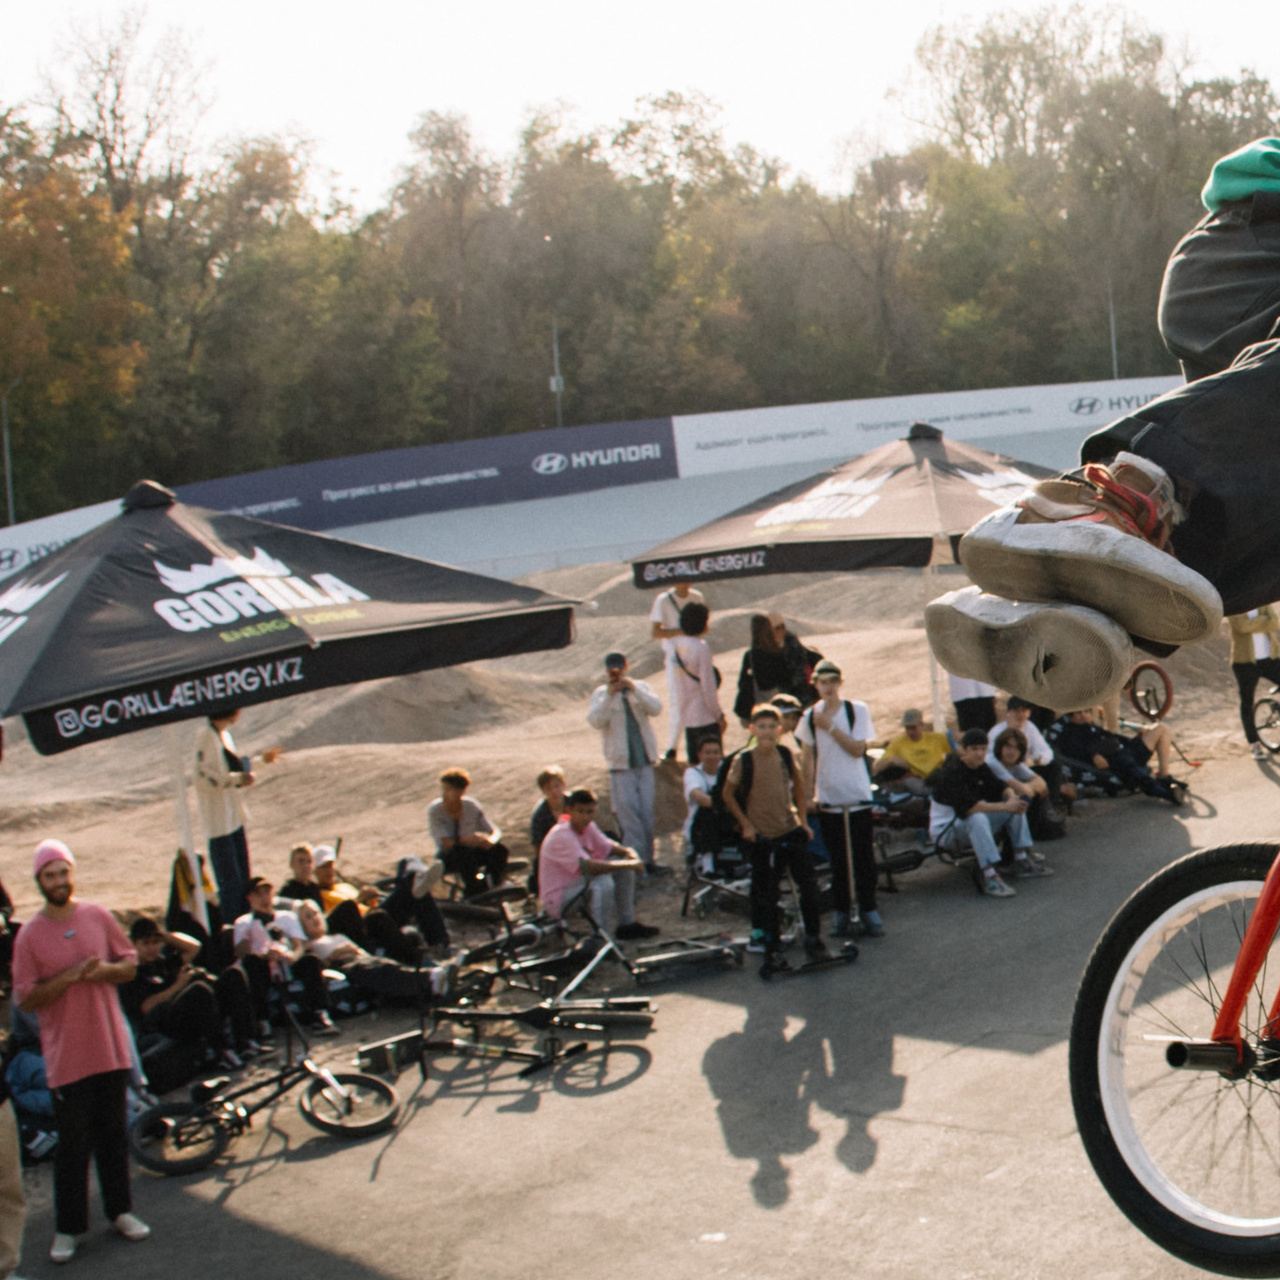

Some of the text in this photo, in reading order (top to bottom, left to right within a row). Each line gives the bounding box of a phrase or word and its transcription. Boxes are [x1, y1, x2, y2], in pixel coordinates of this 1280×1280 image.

[571, 443, 661, 469] HYUNDAI
[153, 573, 372, 632] GORILLA
[219, 616, 299, 643] ENERGY
